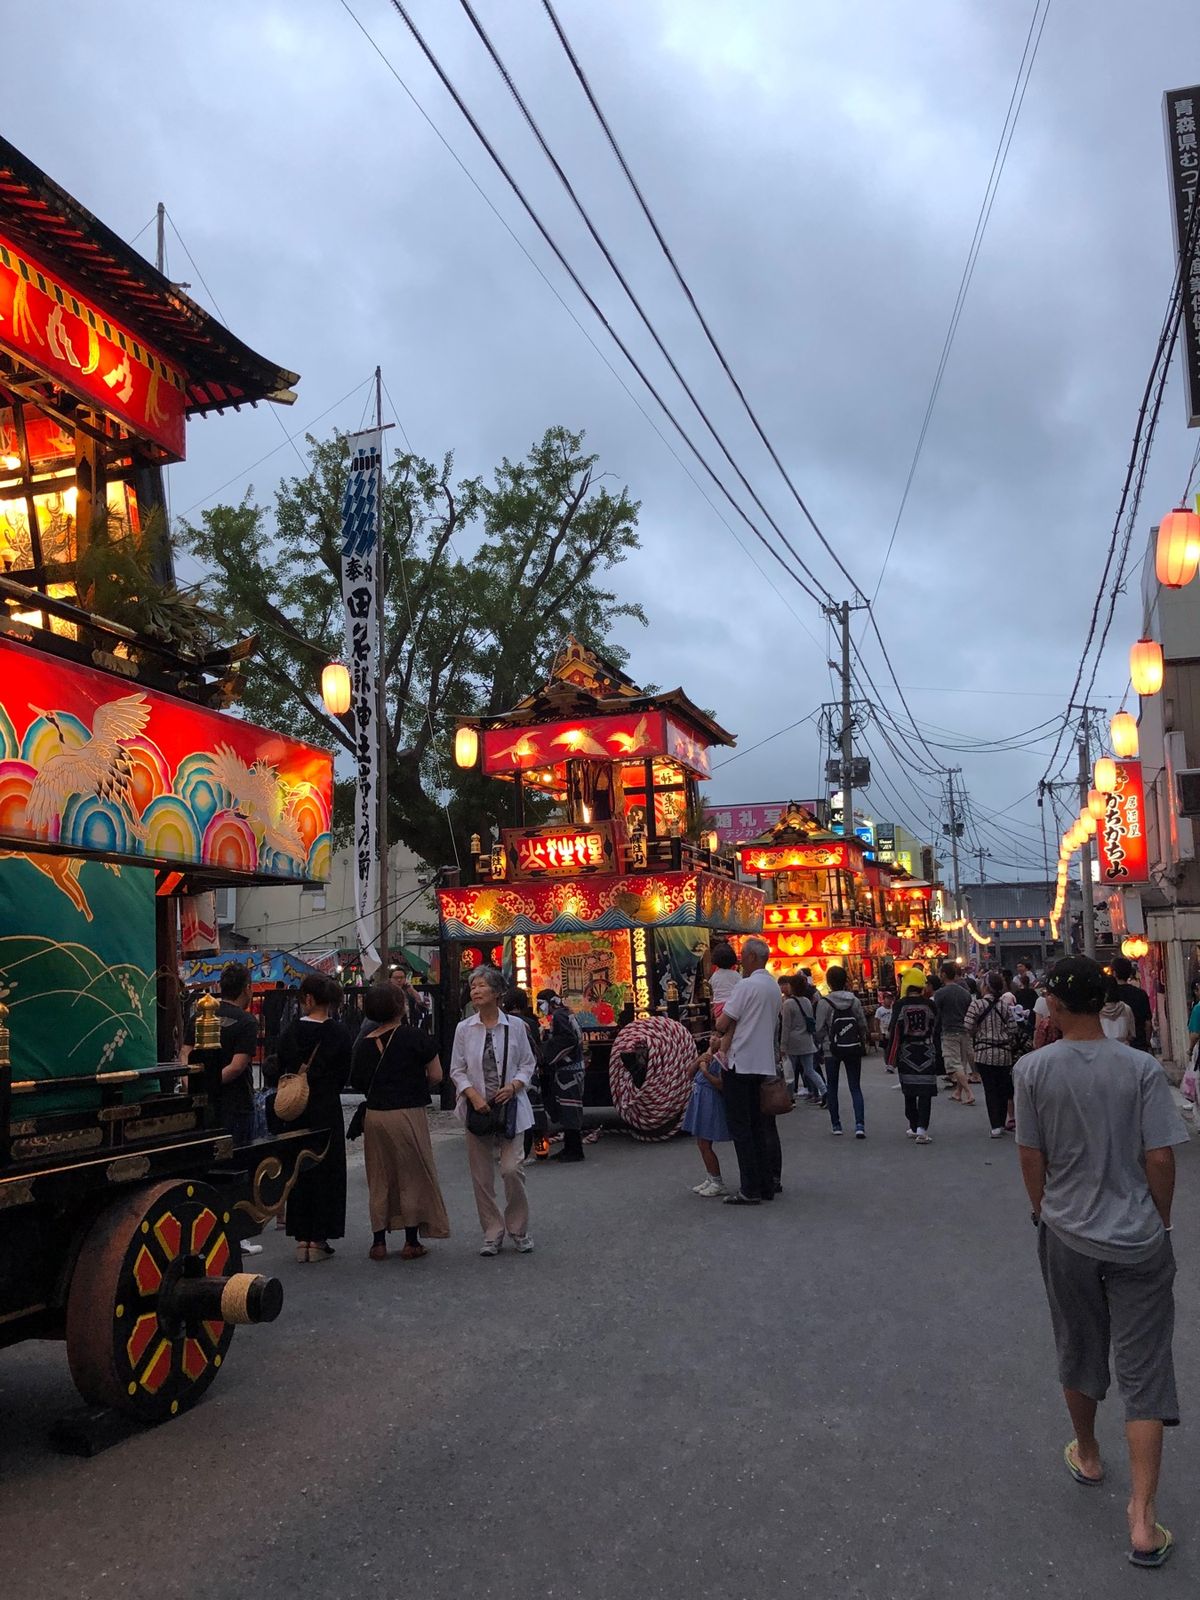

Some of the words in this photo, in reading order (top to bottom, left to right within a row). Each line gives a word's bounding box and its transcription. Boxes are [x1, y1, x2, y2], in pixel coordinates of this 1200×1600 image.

[1102, 792, 1128, 879] かちかち山
[1123, 796, 1142, 838] 居酒屋
